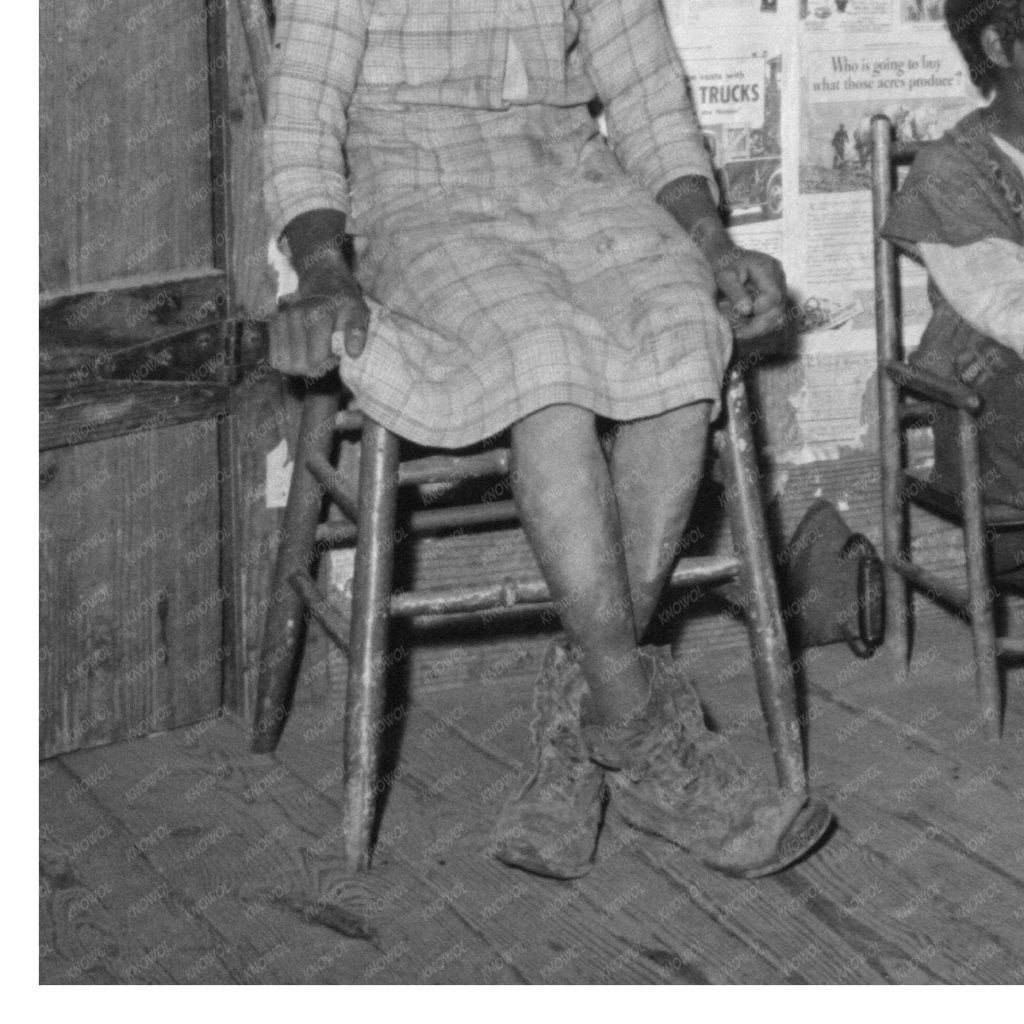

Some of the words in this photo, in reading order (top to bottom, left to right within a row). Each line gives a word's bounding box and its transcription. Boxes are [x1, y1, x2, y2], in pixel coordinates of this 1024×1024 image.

[831, 55, 859, 73] Who
[861, 56, 871, 72] is
[873, 56, 904, 76] going
[907, 56, 920, 71] to
[922, 54, 943, 74] buy
[812, 78, 840, 92] what
[843, 76, 874, 91] those
[876, 78, 906, 90] acres
[908, 70, 963, 93] produce?
[699, 83, 760, 106] TRUCKS
